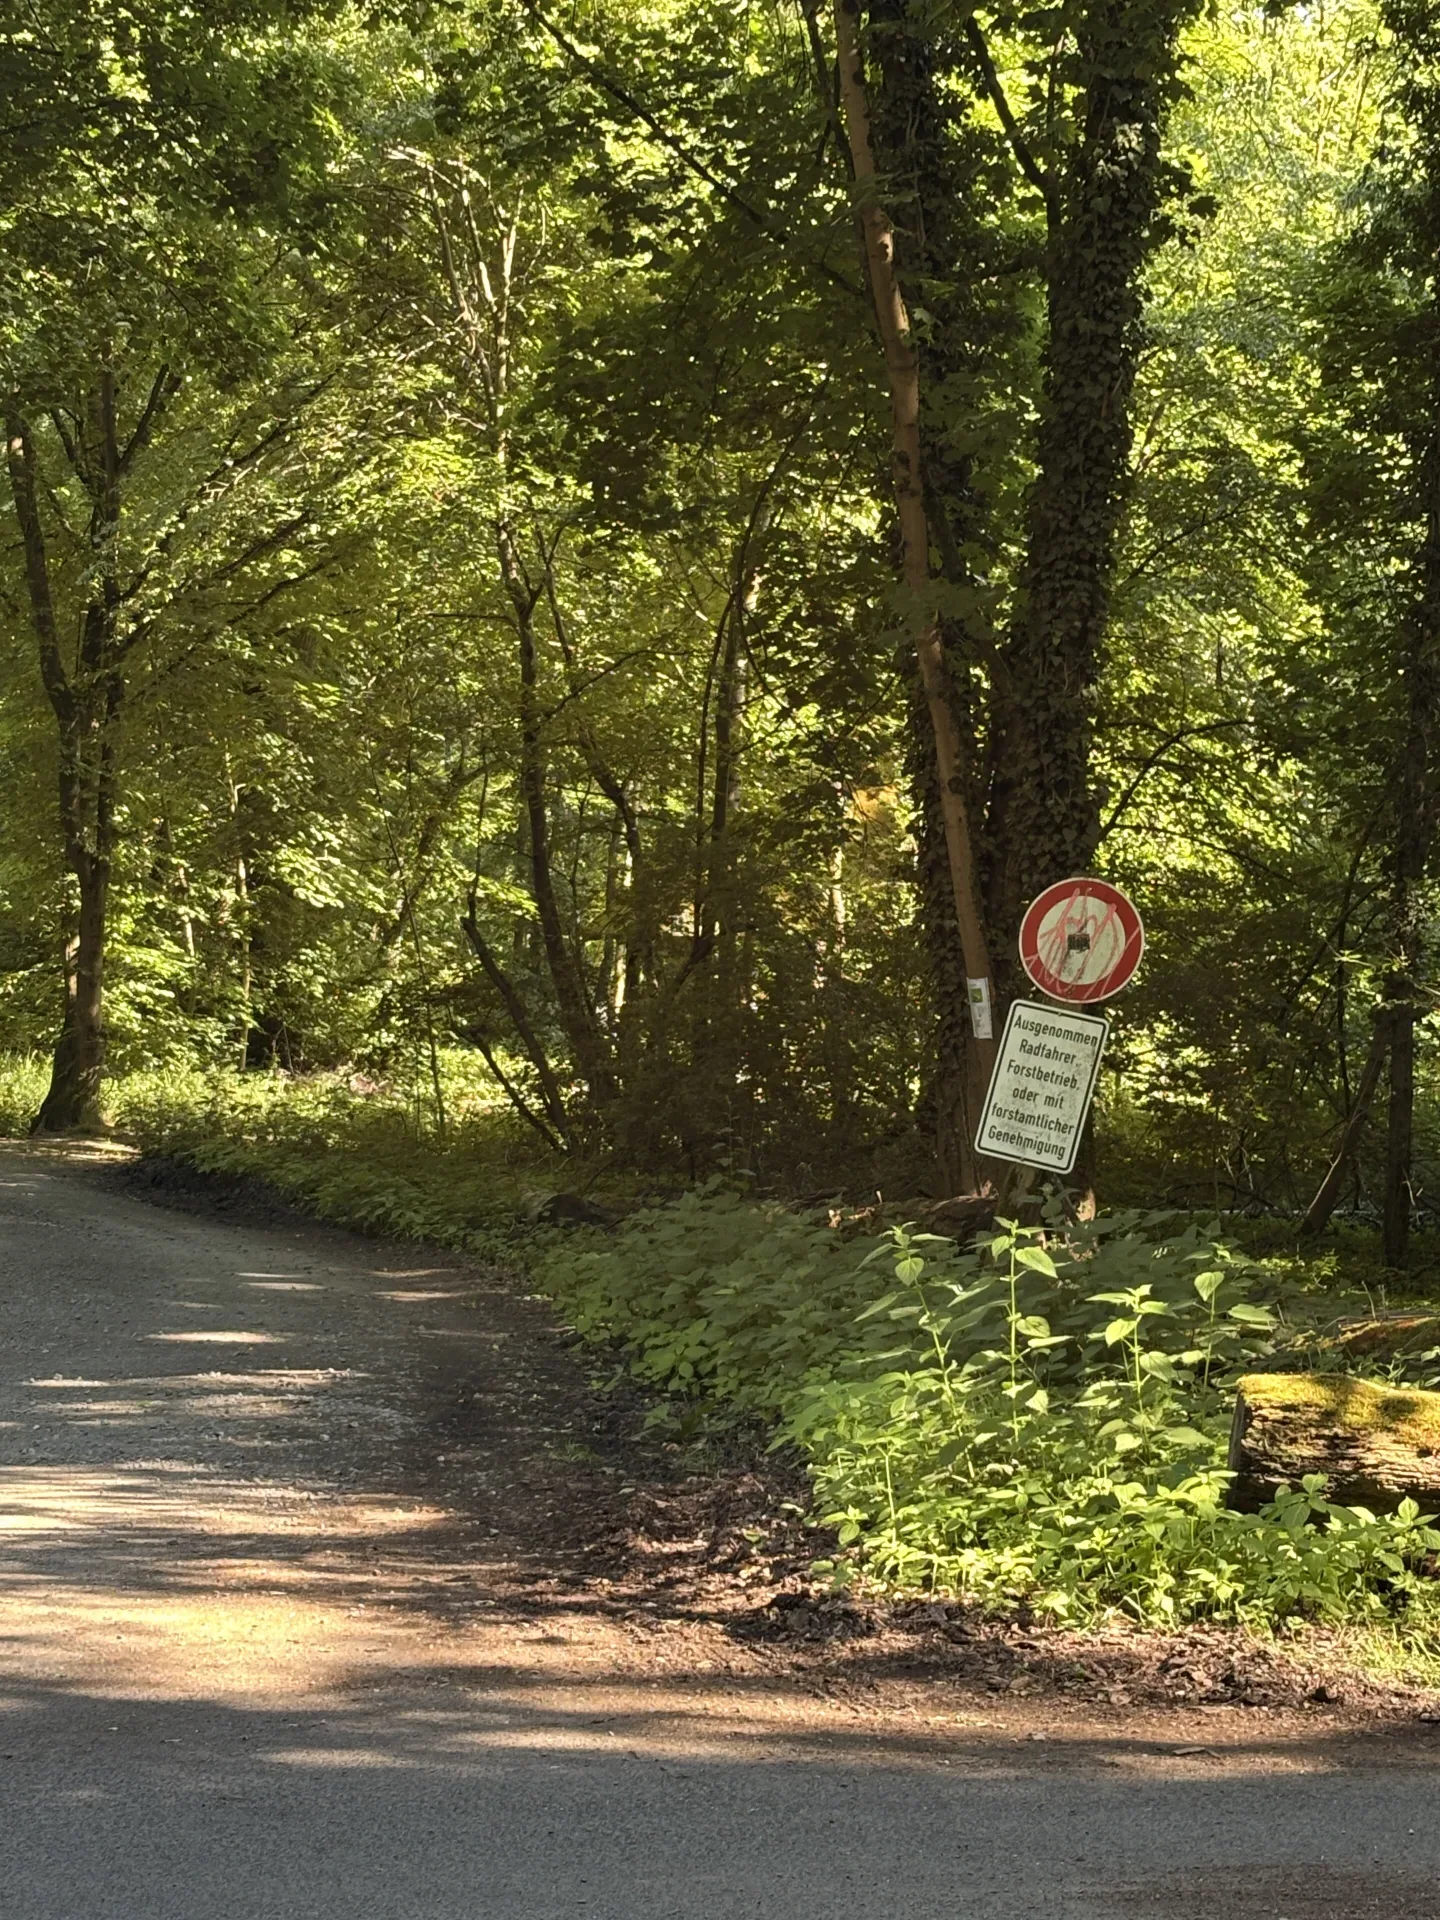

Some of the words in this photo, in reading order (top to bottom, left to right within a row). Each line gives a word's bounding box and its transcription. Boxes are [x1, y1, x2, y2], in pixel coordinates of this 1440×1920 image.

[1013, 1015, 1099, 1047] Ausgenommen
[1012, 1086, 1039, 1103] oder
[1044, 1092, 1064, 1109] mit
[991, 1103, 1075, 1135] forstamtlicher
[988, 1125, 1066, 1160] Genehmigung
